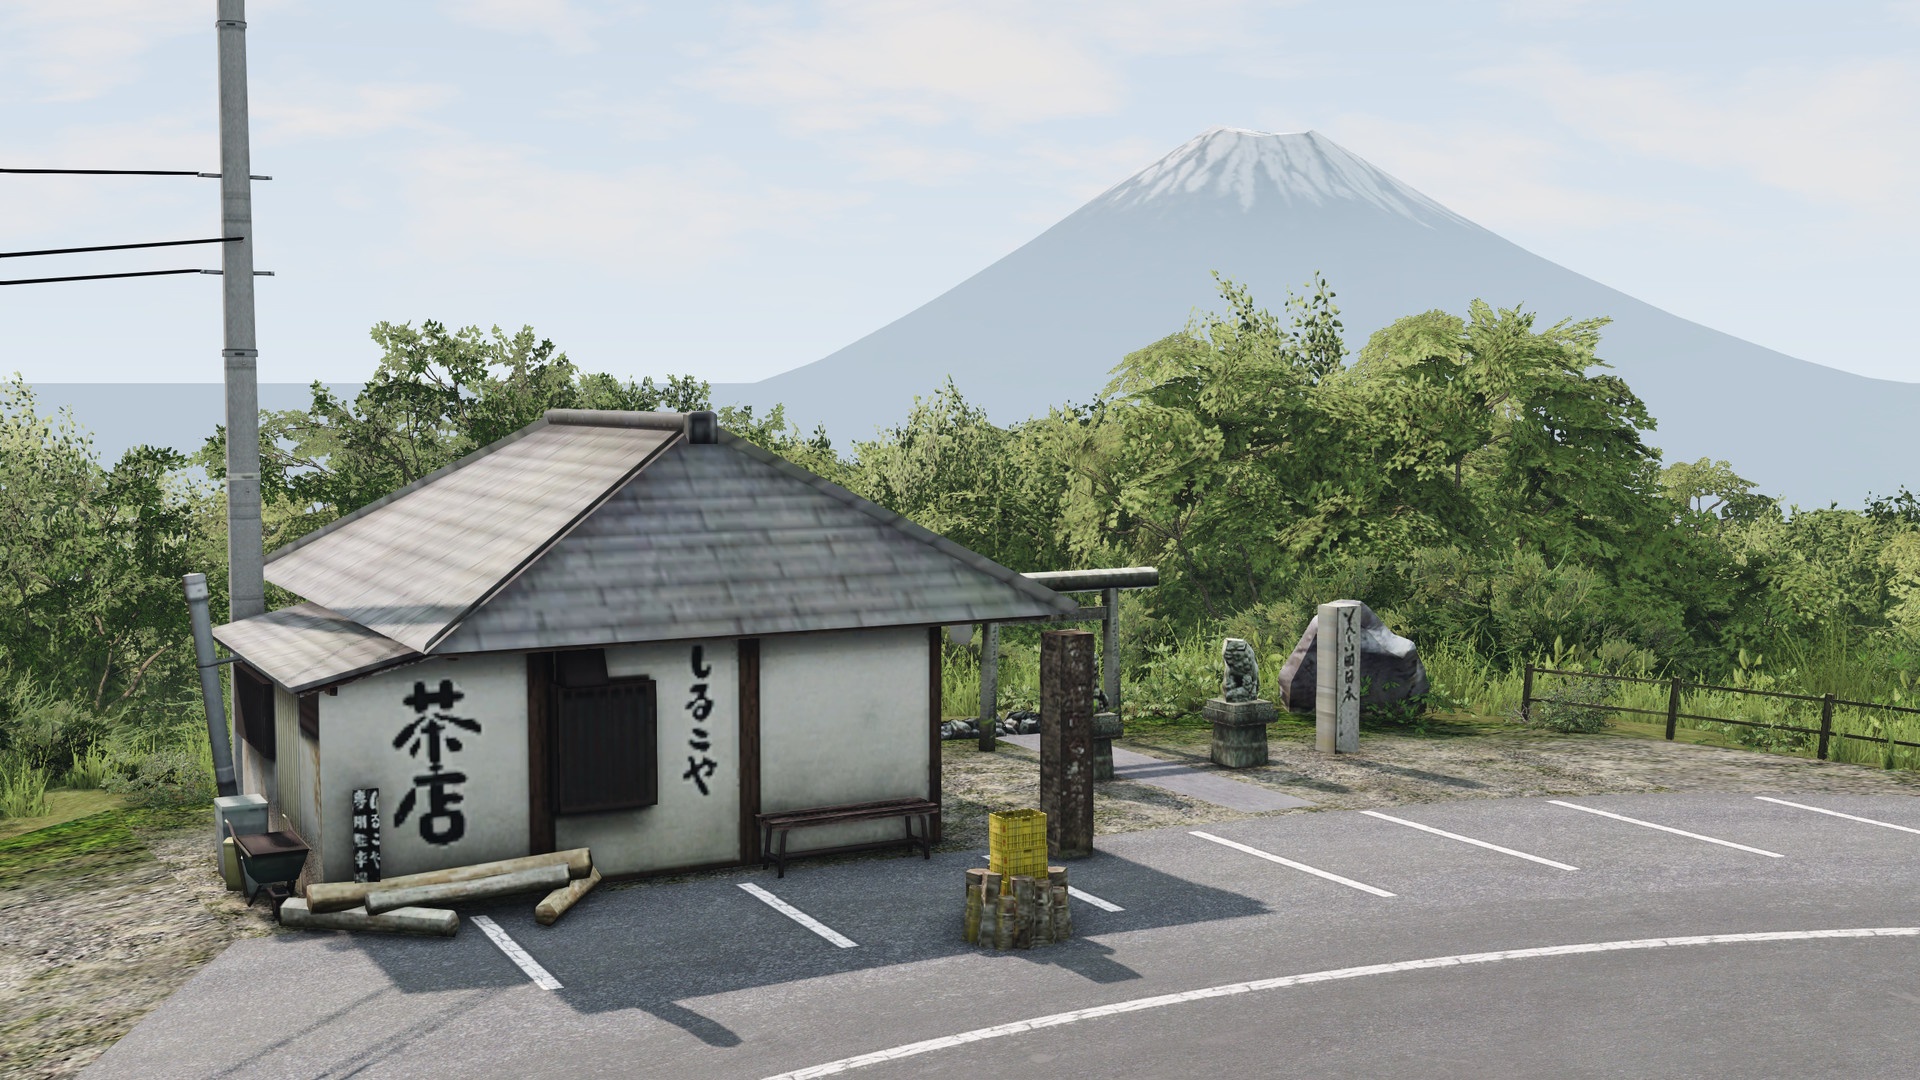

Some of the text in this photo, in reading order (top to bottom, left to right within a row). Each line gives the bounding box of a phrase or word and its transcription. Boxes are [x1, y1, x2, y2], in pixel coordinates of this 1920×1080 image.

[393, 679, 482, 845] 茶店
[683, 645, 718, 796] しるこや
[369, 790, 381, 869] しるこや
